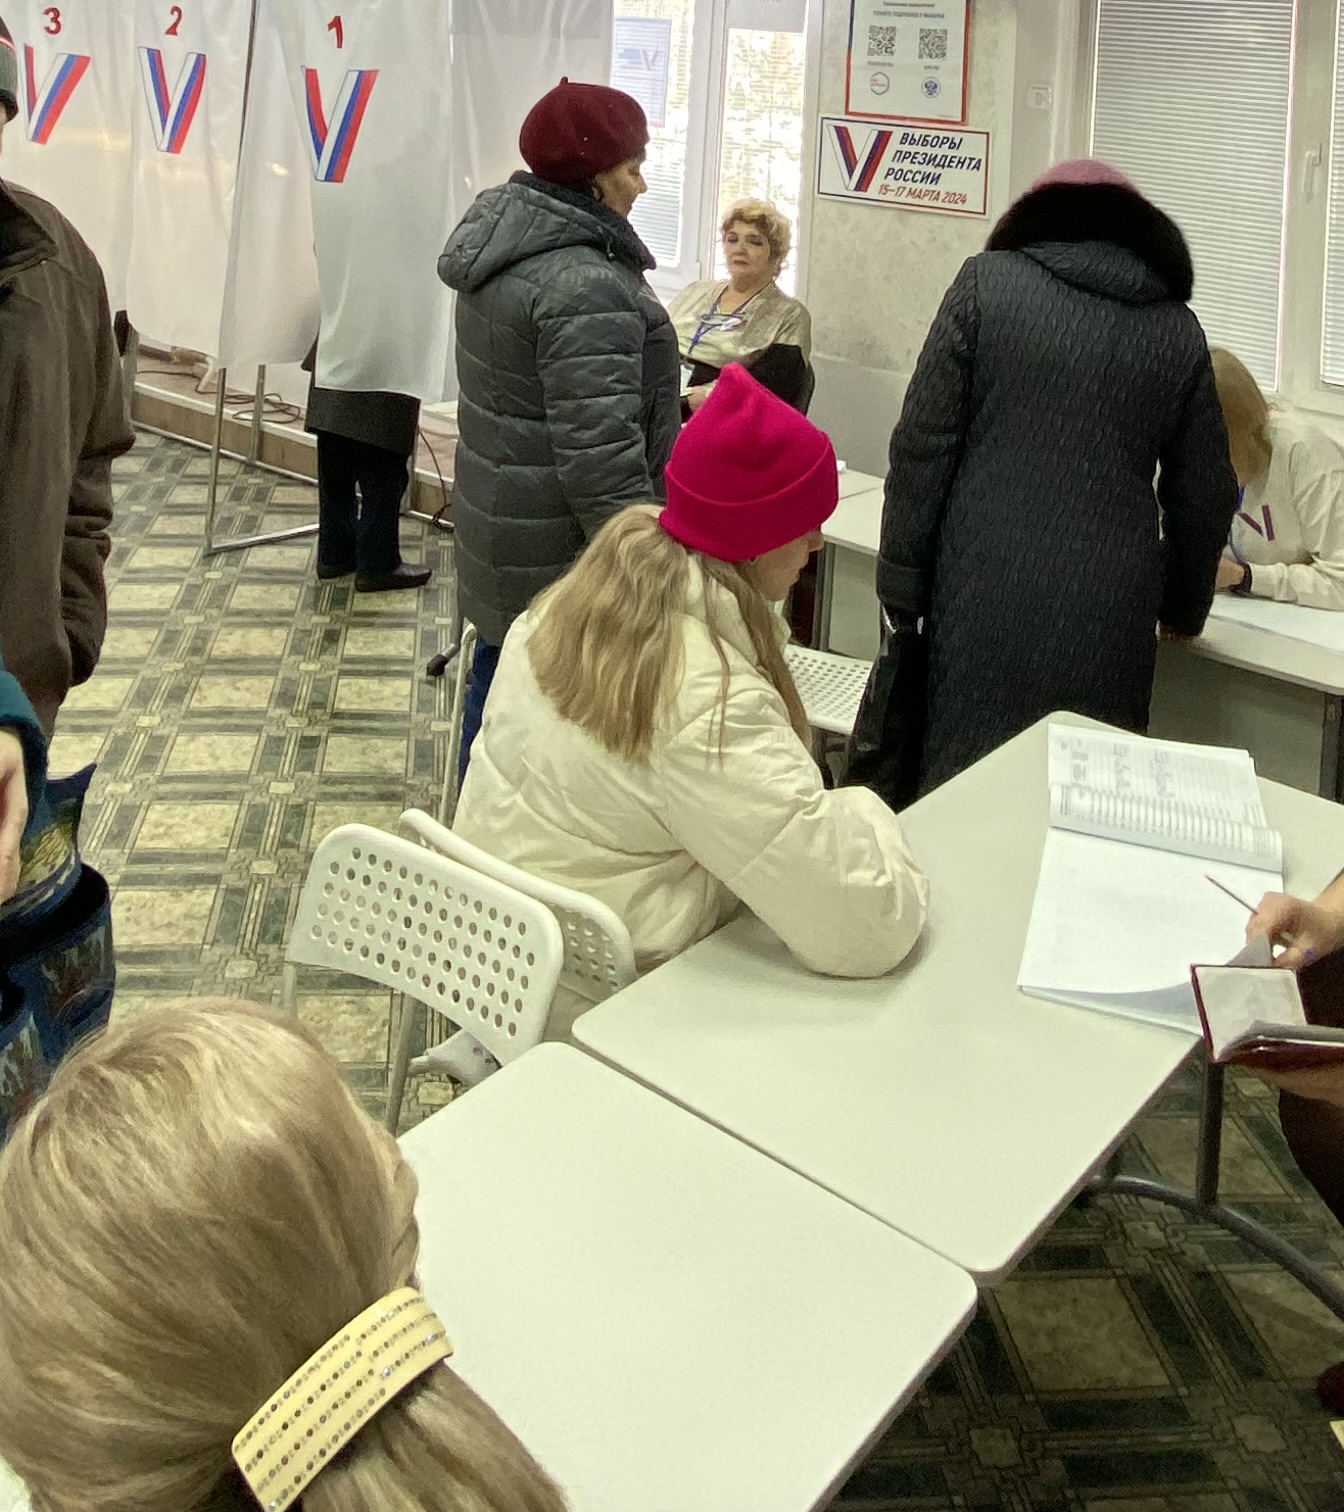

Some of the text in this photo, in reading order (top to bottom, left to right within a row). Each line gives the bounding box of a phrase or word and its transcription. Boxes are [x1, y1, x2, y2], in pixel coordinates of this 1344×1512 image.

[43, 7, 62, 35] 3
[164, 5, 183, 36] 2
[327, 15, 344, 48] 1
[899, 132, 963, 150] ВЫБОРЫ
[891, 150, 982, 171] ПРЕЗИДЕНТА
[884, 167, 942, 185] РОССИИ
[906, 187, 941, 201] МАРТА
[941, 192, 967, 205] 2024
